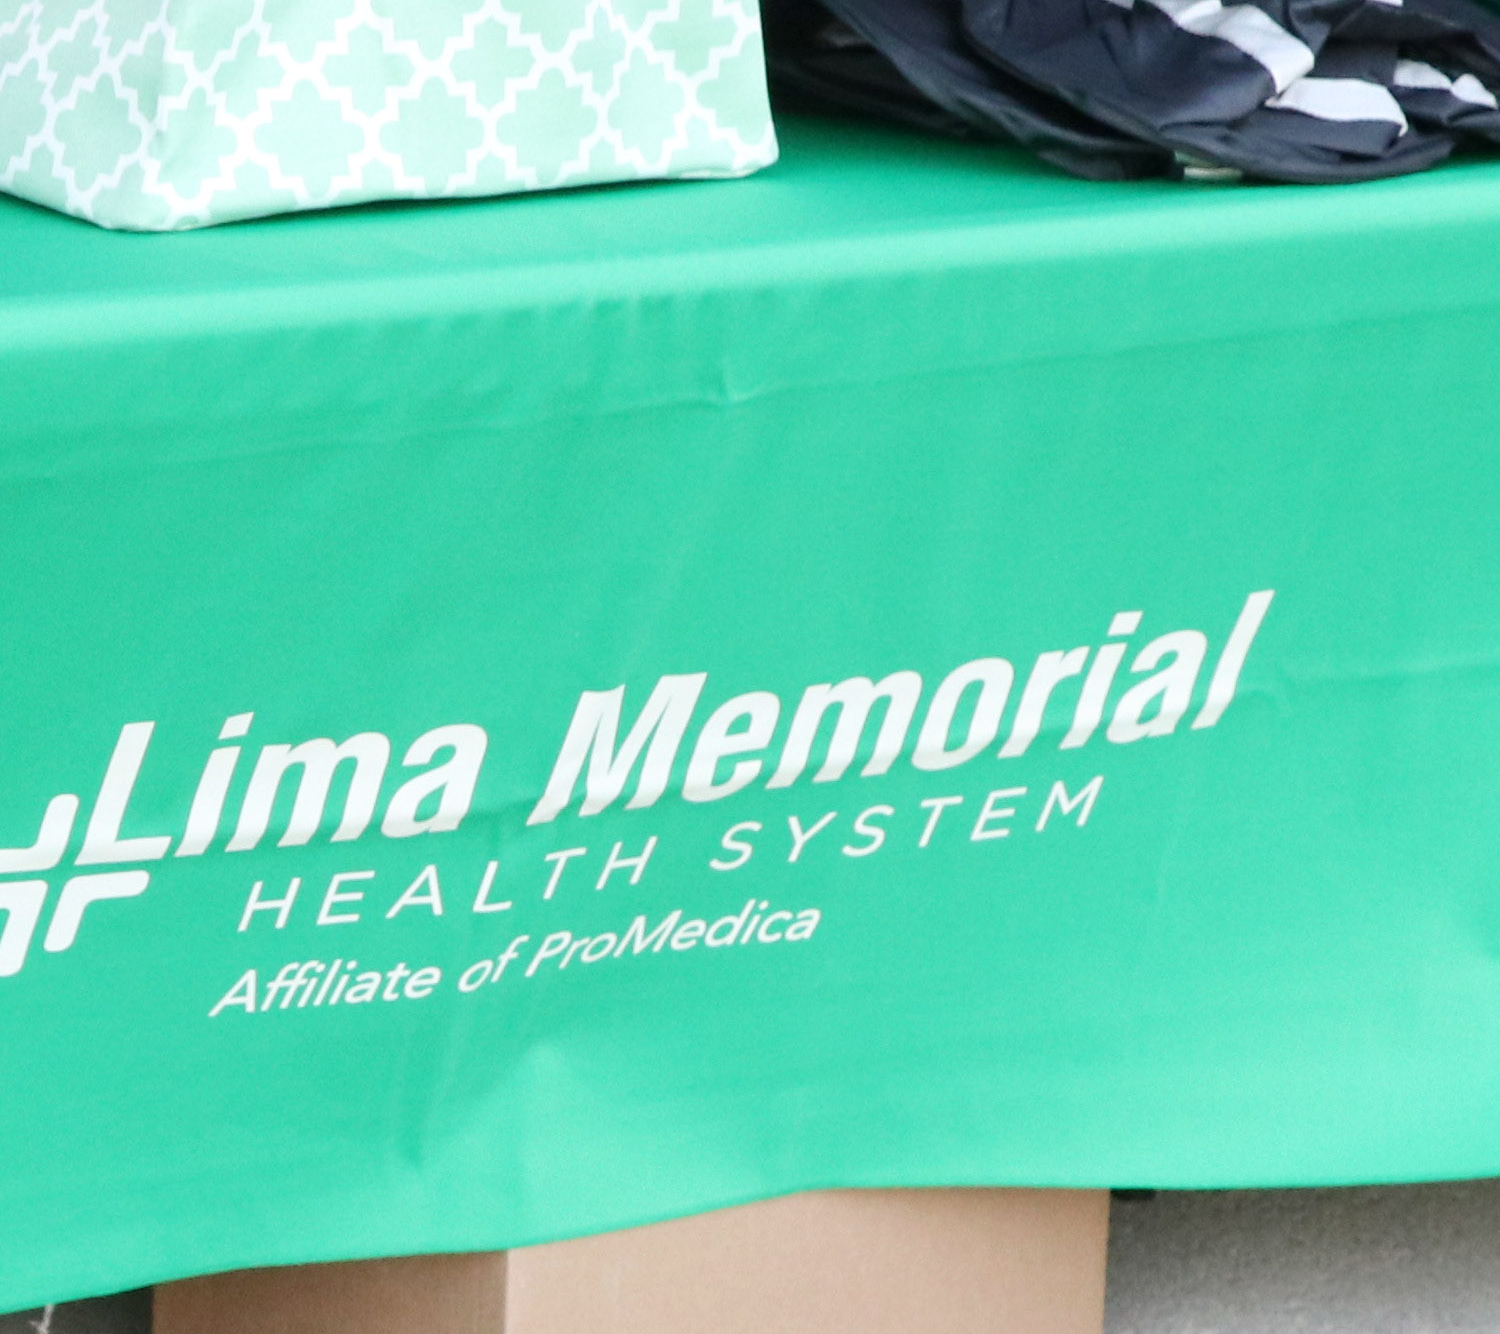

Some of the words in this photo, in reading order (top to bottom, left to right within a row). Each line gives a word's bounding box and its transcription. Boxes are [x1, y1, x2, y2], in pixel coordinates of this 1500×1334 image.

[75, 711, 489, 865] Lima
[525, 589, 1276, 826] Memorial
[236, 834, 658, 933] HEALTH
[708, 774, 1105, 871] SYSTEM
[208, 951, 442, 1018] Affiliate
[457, 934, 530, 993] of
[525, 898, 822, 978] ProMedica
